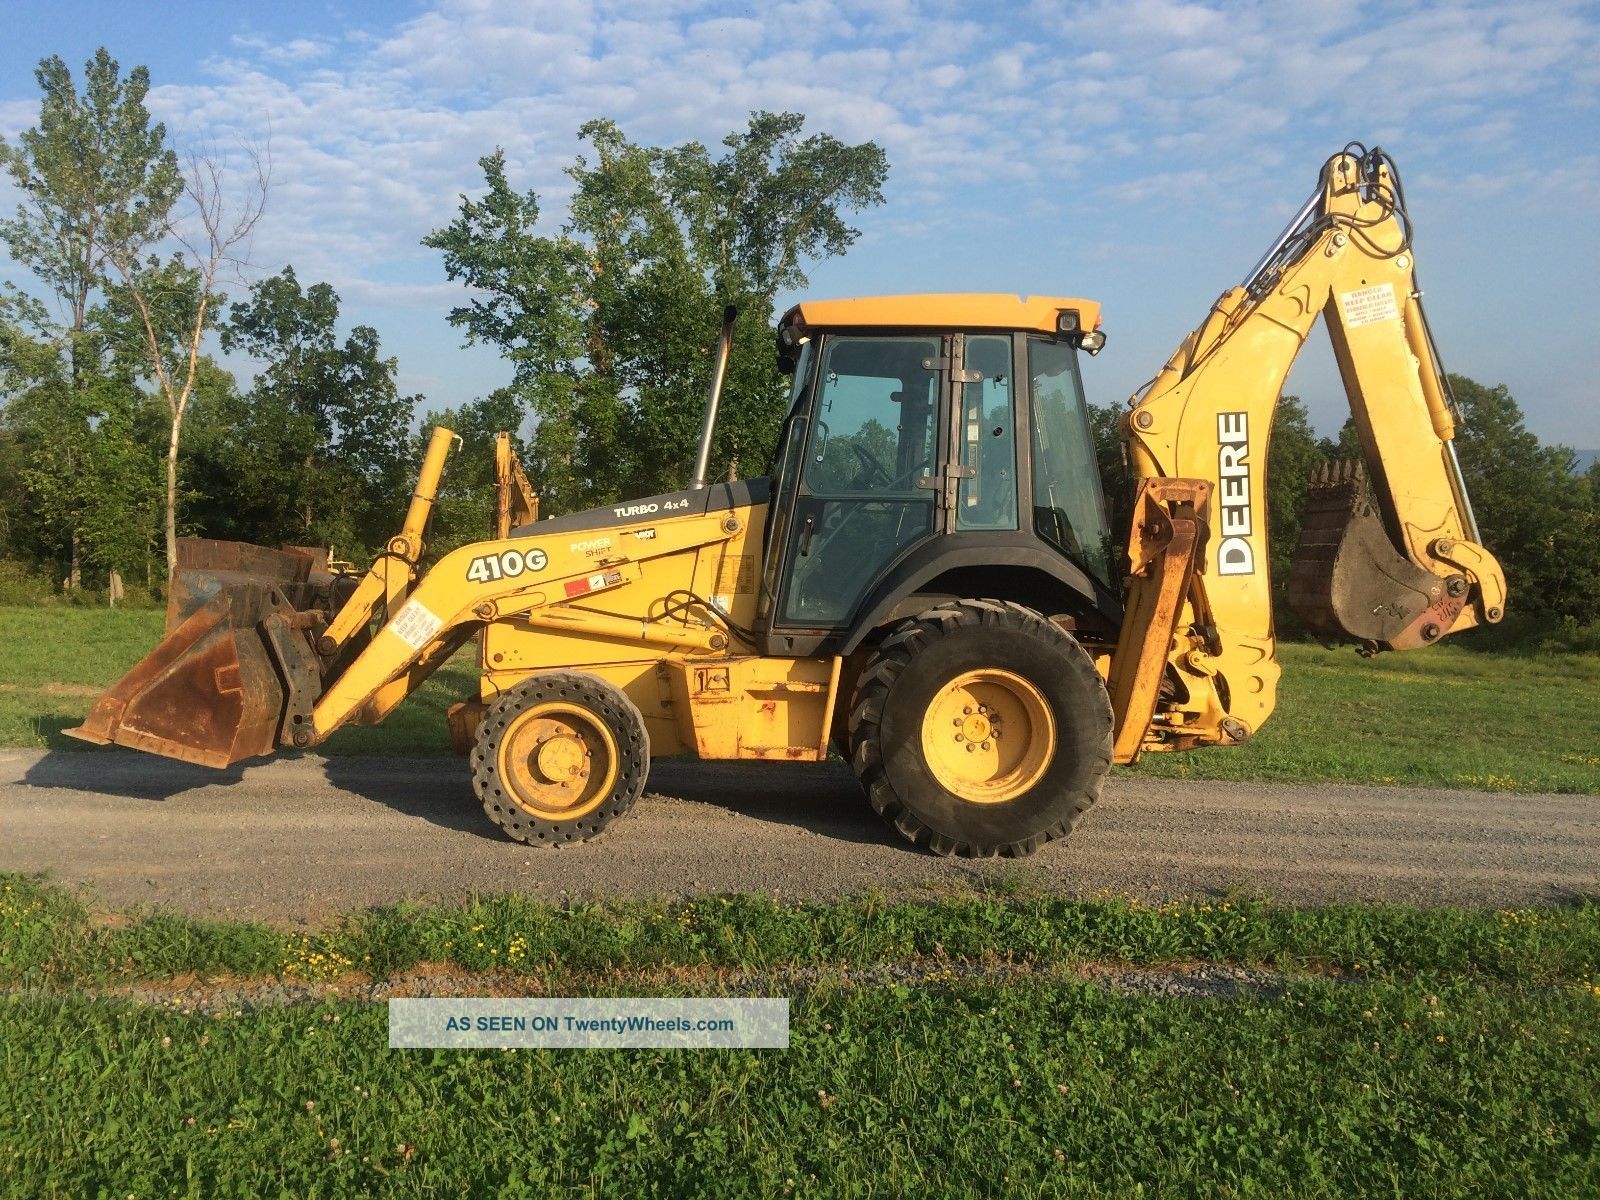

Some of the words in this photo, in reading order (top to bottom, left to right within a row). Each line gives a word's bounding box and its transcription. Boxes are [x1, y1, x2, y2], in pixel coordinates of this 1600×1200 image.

[1217, 411, 1255, 576] DEERE
[613, 503, 659, 518] TURBO
[663, 498, 689, 510] 4x4
[569, 537, 611, 553] POWER
[585, 546, 612, 558] SHIFT
[466, 548, 548, 584] 410G
